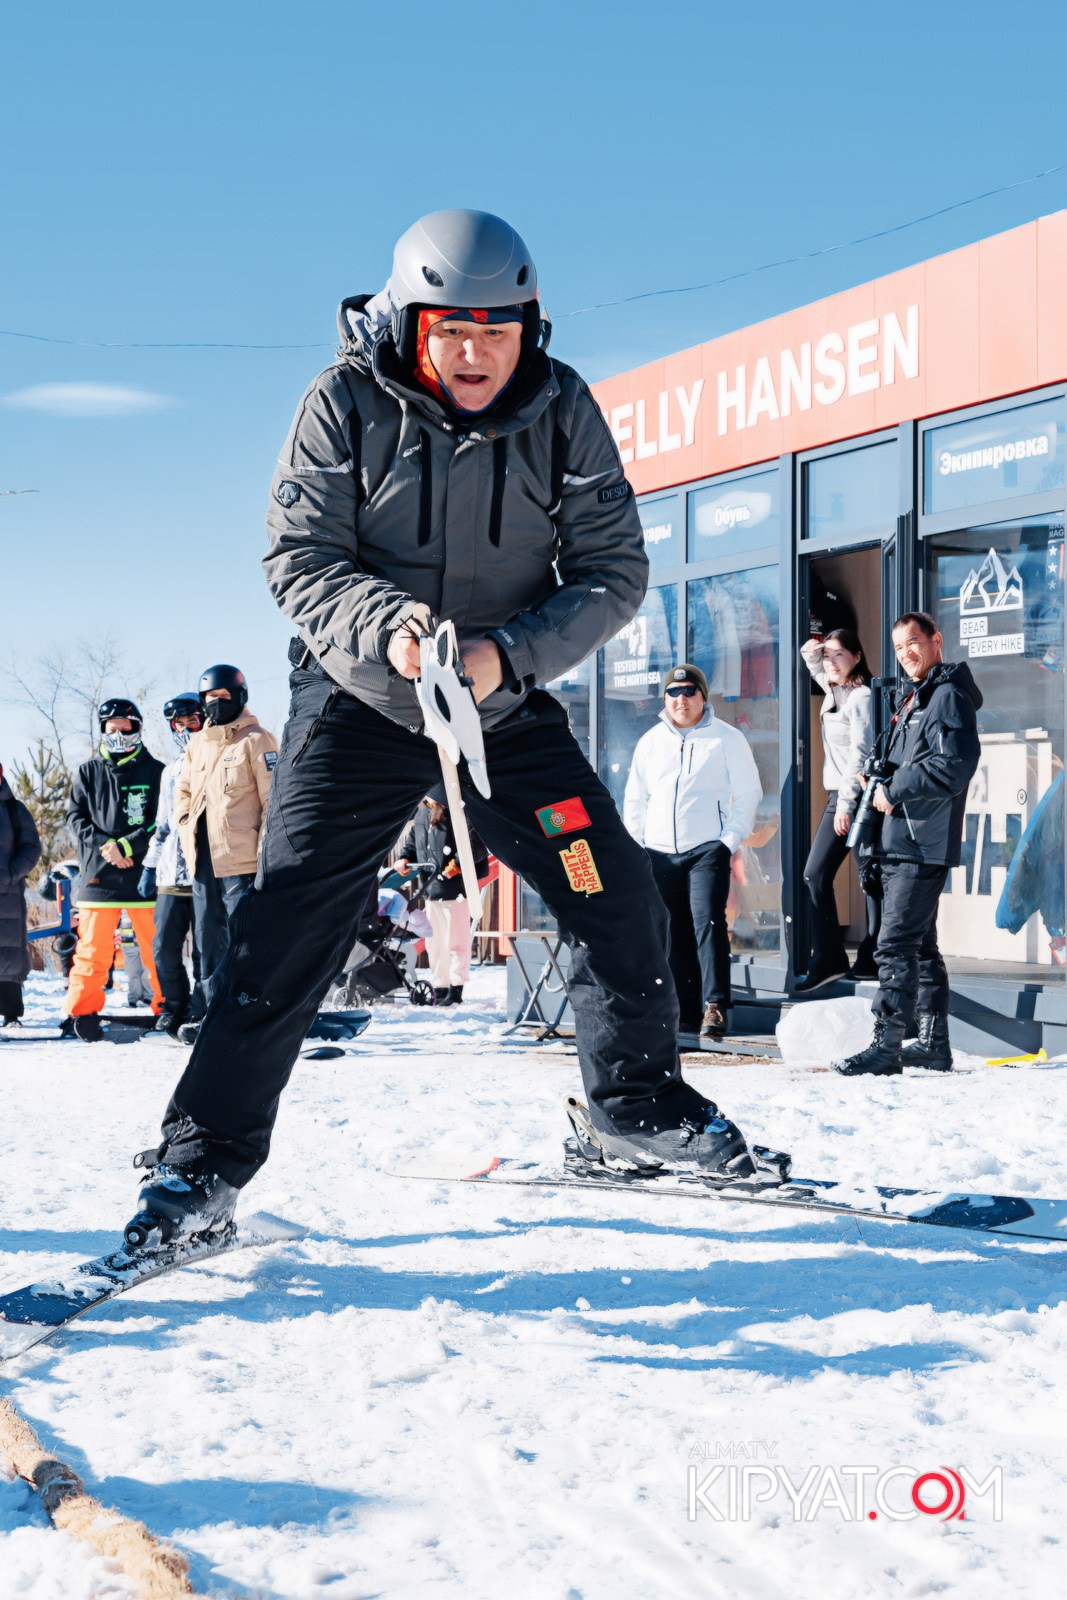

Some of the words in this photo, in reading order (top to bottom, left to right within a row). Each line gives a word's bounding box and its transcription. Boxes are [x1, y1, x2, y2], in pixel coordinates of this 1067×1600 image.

[604, 378, 704, 464] ELLY
[717, 304, 919, 436] HANSEN
[939, 435, 1048, 475] Экипировка
[714, 505, 750, 528] Обувь
[642, 523, 672, 548] уары
[962, 620, 985, 634] GEAR
[971, 639, 999, 654] EVERY
[1001, 637, 1022, 651] HIKE
[613, 660, 636, 674] TESTED
[637, 658, 646, 672] BY
[613, 675, 626, 689] THE
[626, 672, 647, 687] NORTH
[647, 671, 661, 685] SEA
[563, 853, 587, 889] SHIT
[574, 842, 600, 891] HAPPENS
